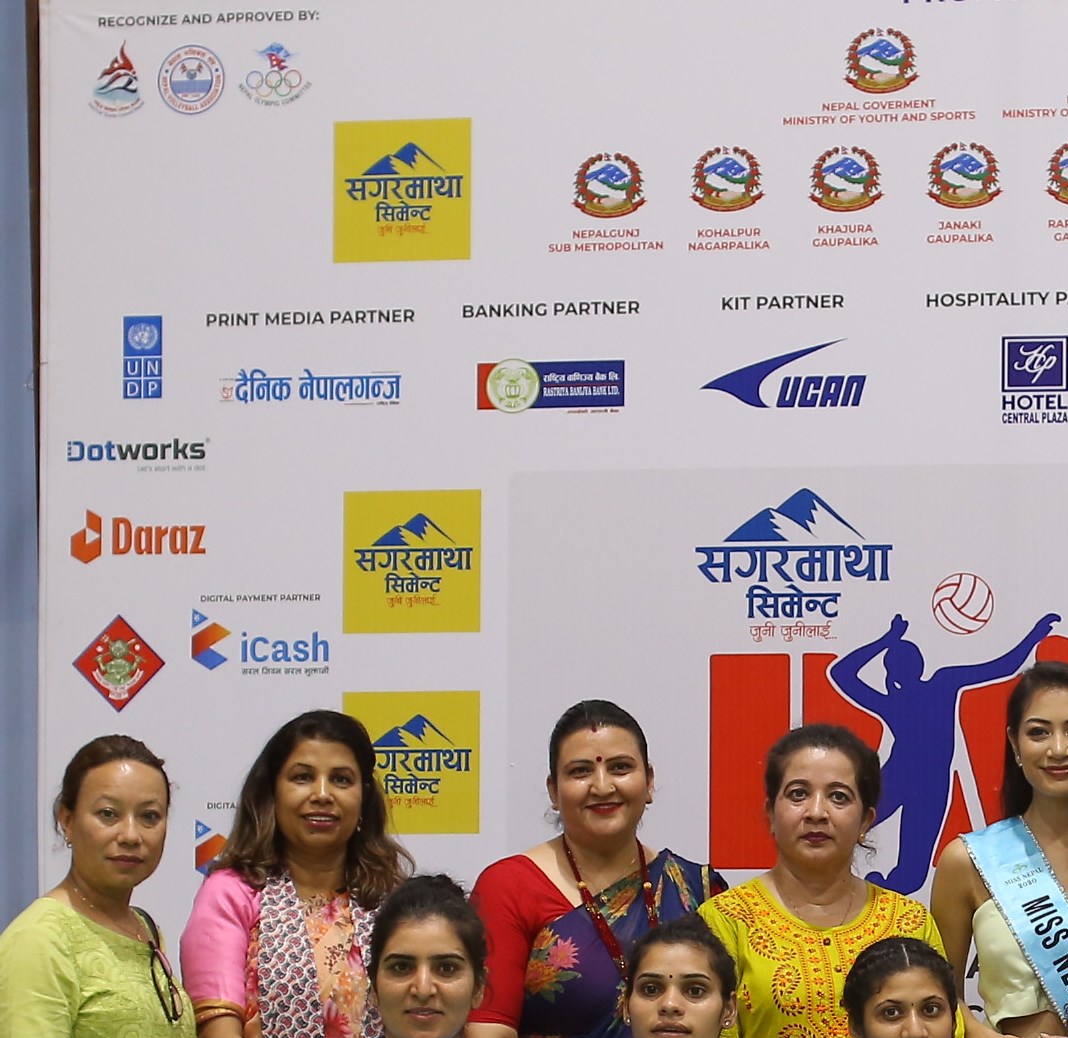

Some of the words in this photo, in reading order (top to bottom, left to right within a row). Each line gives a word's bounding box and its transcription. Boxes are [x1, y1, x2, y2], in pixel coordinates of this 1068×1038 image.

[98, 14, 178, 28] RECOGNIZE
[182, 13, 212, 26] AND
[216, 12, 295, 25] APPROVED
[298, 10, 320, 22] BY:
[821, 101, 859, 111] NEPAL
[863, 99, 935, 110] GOVERMENT
[1002, 108, 1057, 119] MINISTRY
[782, 115, 836, 125] MINISTRY
[839, 115, 854, 125] OF
[858, 113, 898, 124] YOUTH
[902, 113, 928, 123] AND
[931, 111, 976, 121] SPORTS
[345, 175, 463, 201] सगरमाथा
[375, 201, 432, 223] सिमेन्ट
[697, 227, 761, 238] KOHALPUR
[817, 224, 873, 235] KHAJURA
[938, 220, 982, 231] JANAKI
[572, 229, 640, 240] NEPALGUNJ
[812, 237, 878, 247] GAUPALIKA
[927, 233, 994, 244] GAUPALIKA
[548, 242, 571, 253] SUB
[574, 240, 664, 252] METROPOLITAN
[688, 240, 770, 251] NAGARPALIKA
[722, 296, 751, 311] KIT
[756, 294, 845, 310] PARTNER
[926, 291, 1049, 308] HOSPITALITY
[462, 303, 548, 318] BANKING
[553, 300, 640, 316] PARTNER
[206, 313, 258, 328] PRINT
[264, 311, 325, 326] MEDIA
[330, 309, 415, 325] PARTNER
[235, 369, 292, 404] दैनिक
[299, 368, 401, 402] नेपालगन्ज
[592, 386, 607, 396] BANK
[777, 375, 866, 407] UCAN
[1002, 394, 1068, 410] HOTEL
[1002, 412, 1039, 424] CENTRAL
[1041, 411, 1068, 423] PLAZA
[67, 438, 205, 462] Dotworks
[112, 517, 206, 555] Daraz
[354, 546, 474, 572] सगरमाथा
[695, 544, 893, 583] सगरमाथा
[385, 572, 441, 594] सिमेन्ट
[237, 594, 277, 602] PAYMENT
[746, 583, 841, 619] सिमेन्ट
[241, 631, 329, 662] iCash
[374, 749, 472, 772] गरमाथा
[384, 773, 441, 794] सिमेन्ट
[206, 802, 238, 811] DIGITA
[1005, 876, 1021, 886] MISS
[1022, 868, 1044, 880] NEPAL
